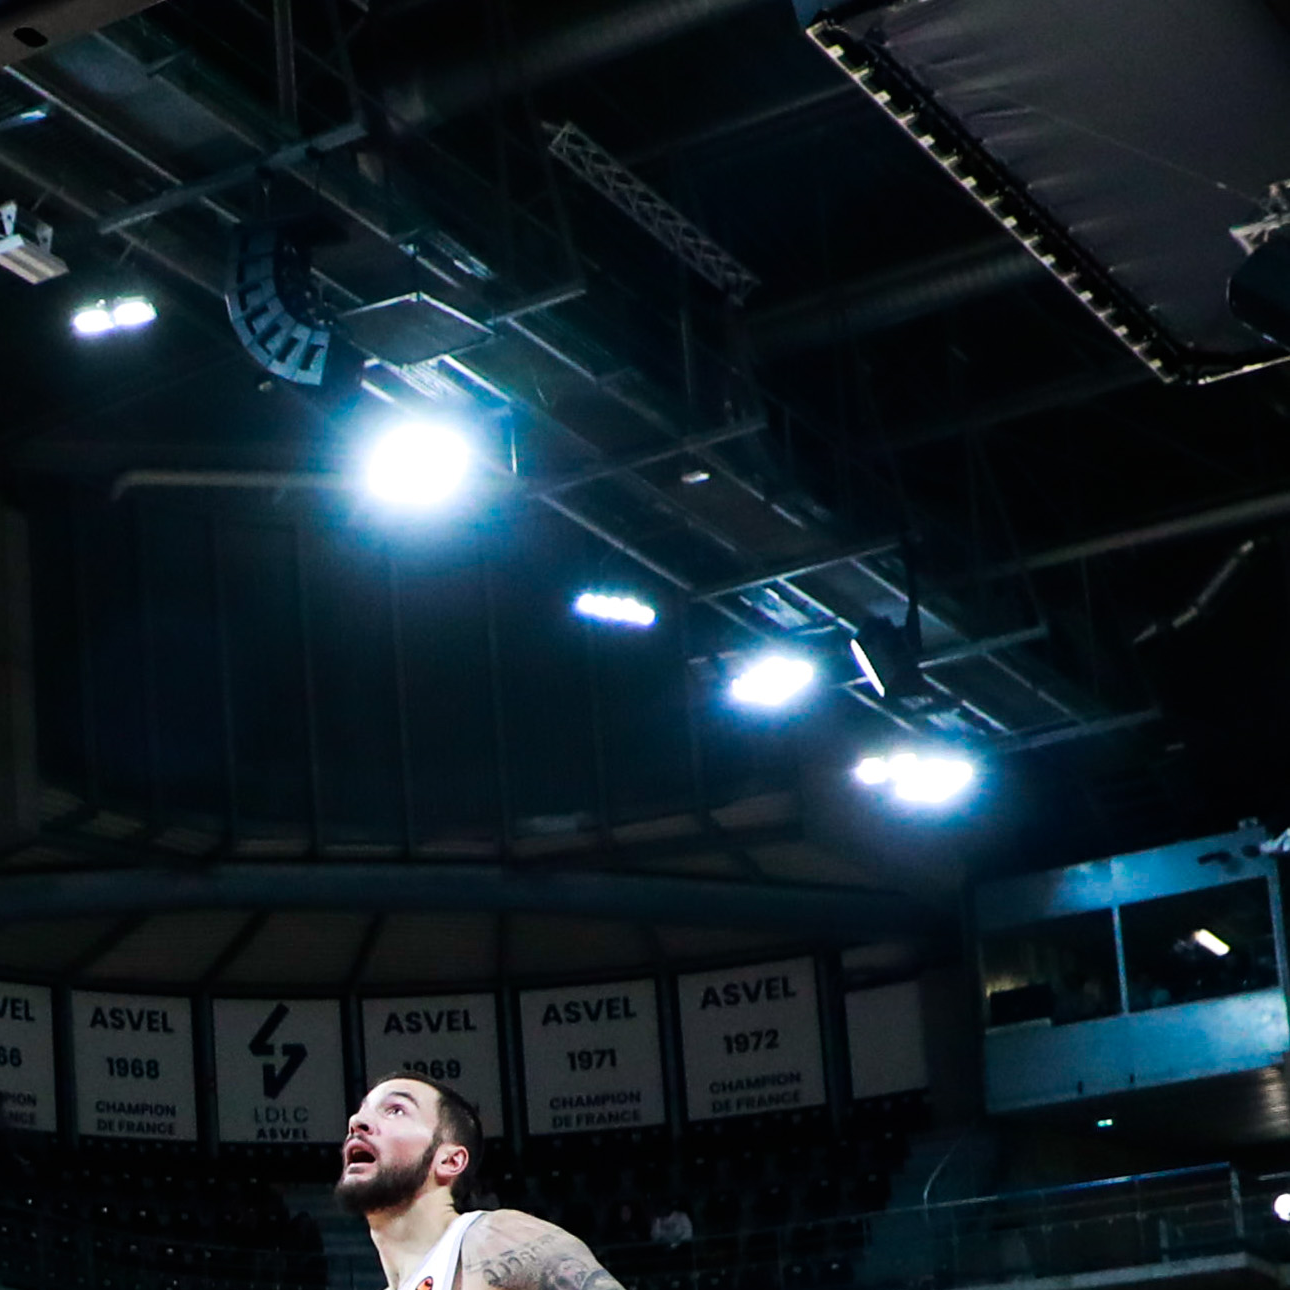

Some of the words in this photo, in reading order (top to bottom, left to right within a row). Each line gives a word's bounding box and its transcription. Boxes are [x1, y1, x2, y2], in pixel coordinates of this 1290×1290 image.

[701, 976, 796, 1010] ASVEL
[90, 1007, 174, 1033] ASVEL
[383, 1009, 477, 1034] ASVEL
[542, 997, 636, 1026] ASVEL
[724, 1029, 779, 1055] 1972
[107, 1057, 160, 1079] 1968
[567, 1048, 616, 1071] 1971
[709, 1071, 801, 1094] CHAMPION
[95, 1100, 176, 1117] CHAMPION
[549, 1091, 641, 1110] CHAMPION
[734, 1090, 801, 1111] FRANCE
[254, 1107, 309, 1123] LDLC
[576, 1109, 641, 1126] FRANCE
[118, 1120, 175, 1135] FRANCE
[256, 1127, 309, 1139] ASVEL
